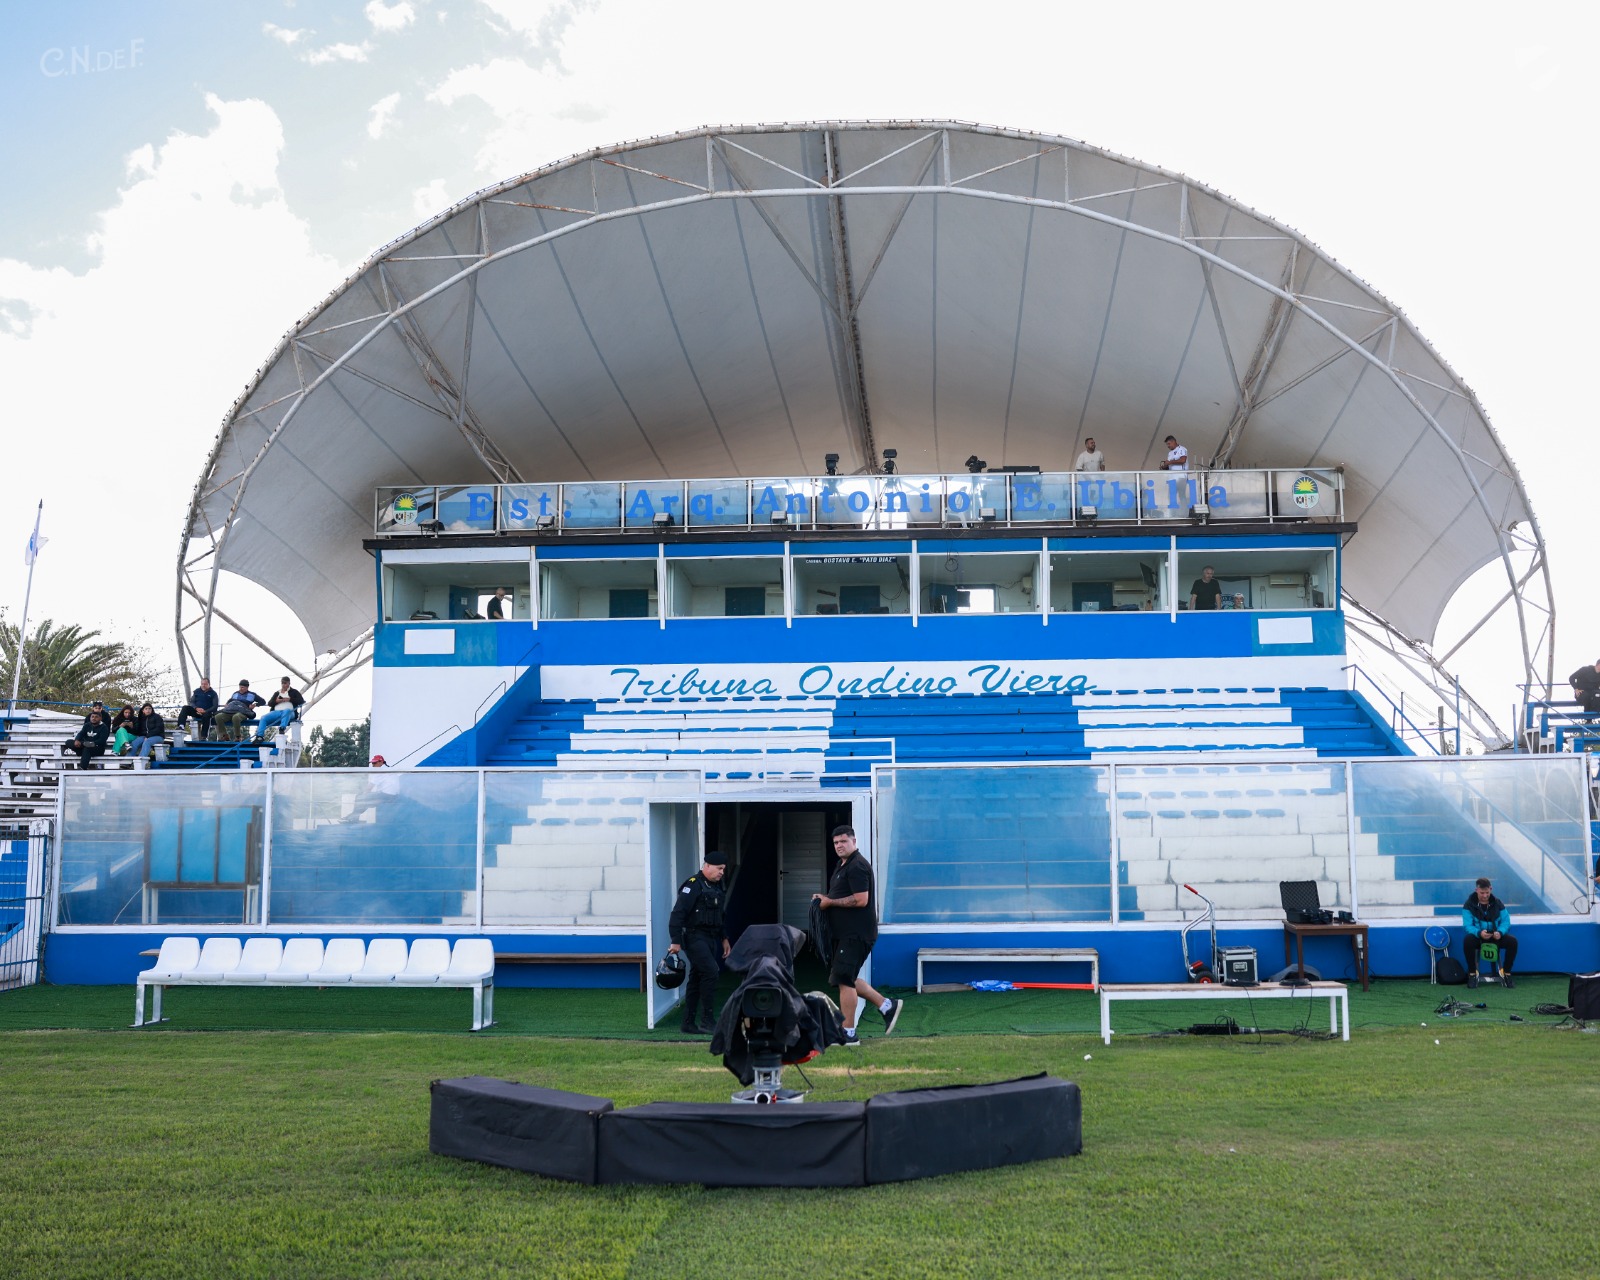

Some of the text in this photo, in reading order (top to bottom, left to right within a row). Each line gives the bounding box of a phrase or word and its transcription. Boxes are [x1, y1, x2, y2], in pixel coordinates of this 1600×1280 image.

[466, 479, 1230, 521] Est. Arq. Antonio E. Ubilla
[610, 664, 1097, 696] Tribuna Ondino Viera
